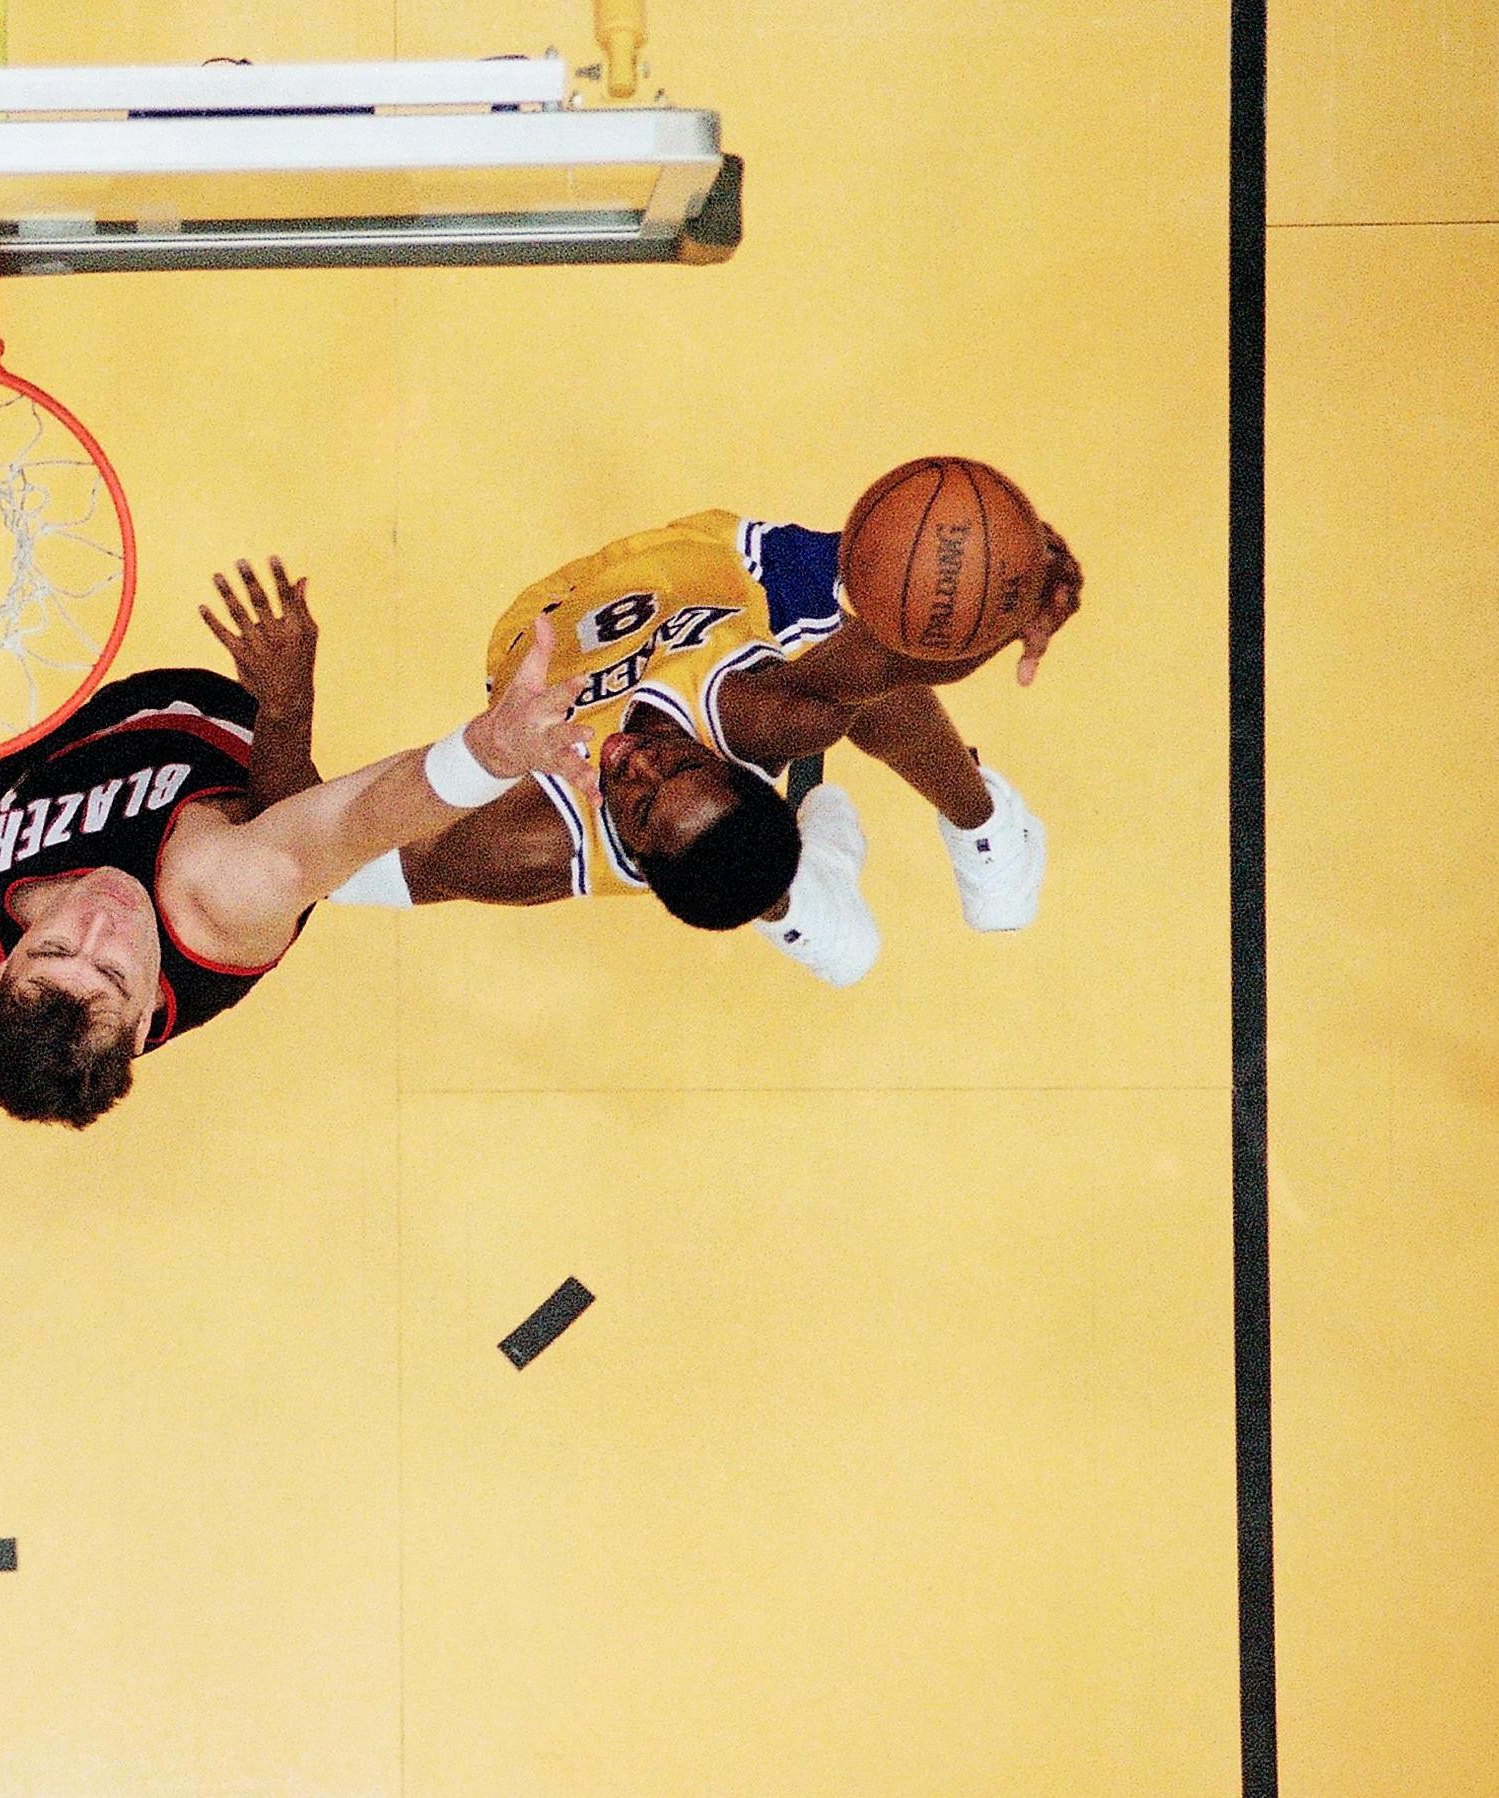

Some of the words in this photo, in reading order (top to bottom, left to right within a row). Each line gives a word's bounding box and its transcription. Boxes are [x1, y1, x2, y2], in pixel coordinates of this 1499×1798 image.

[579, 592, 658, 649] 8
[919, 519, 973, 648] SPALDING
[564, 606, 743, 722] LAER
